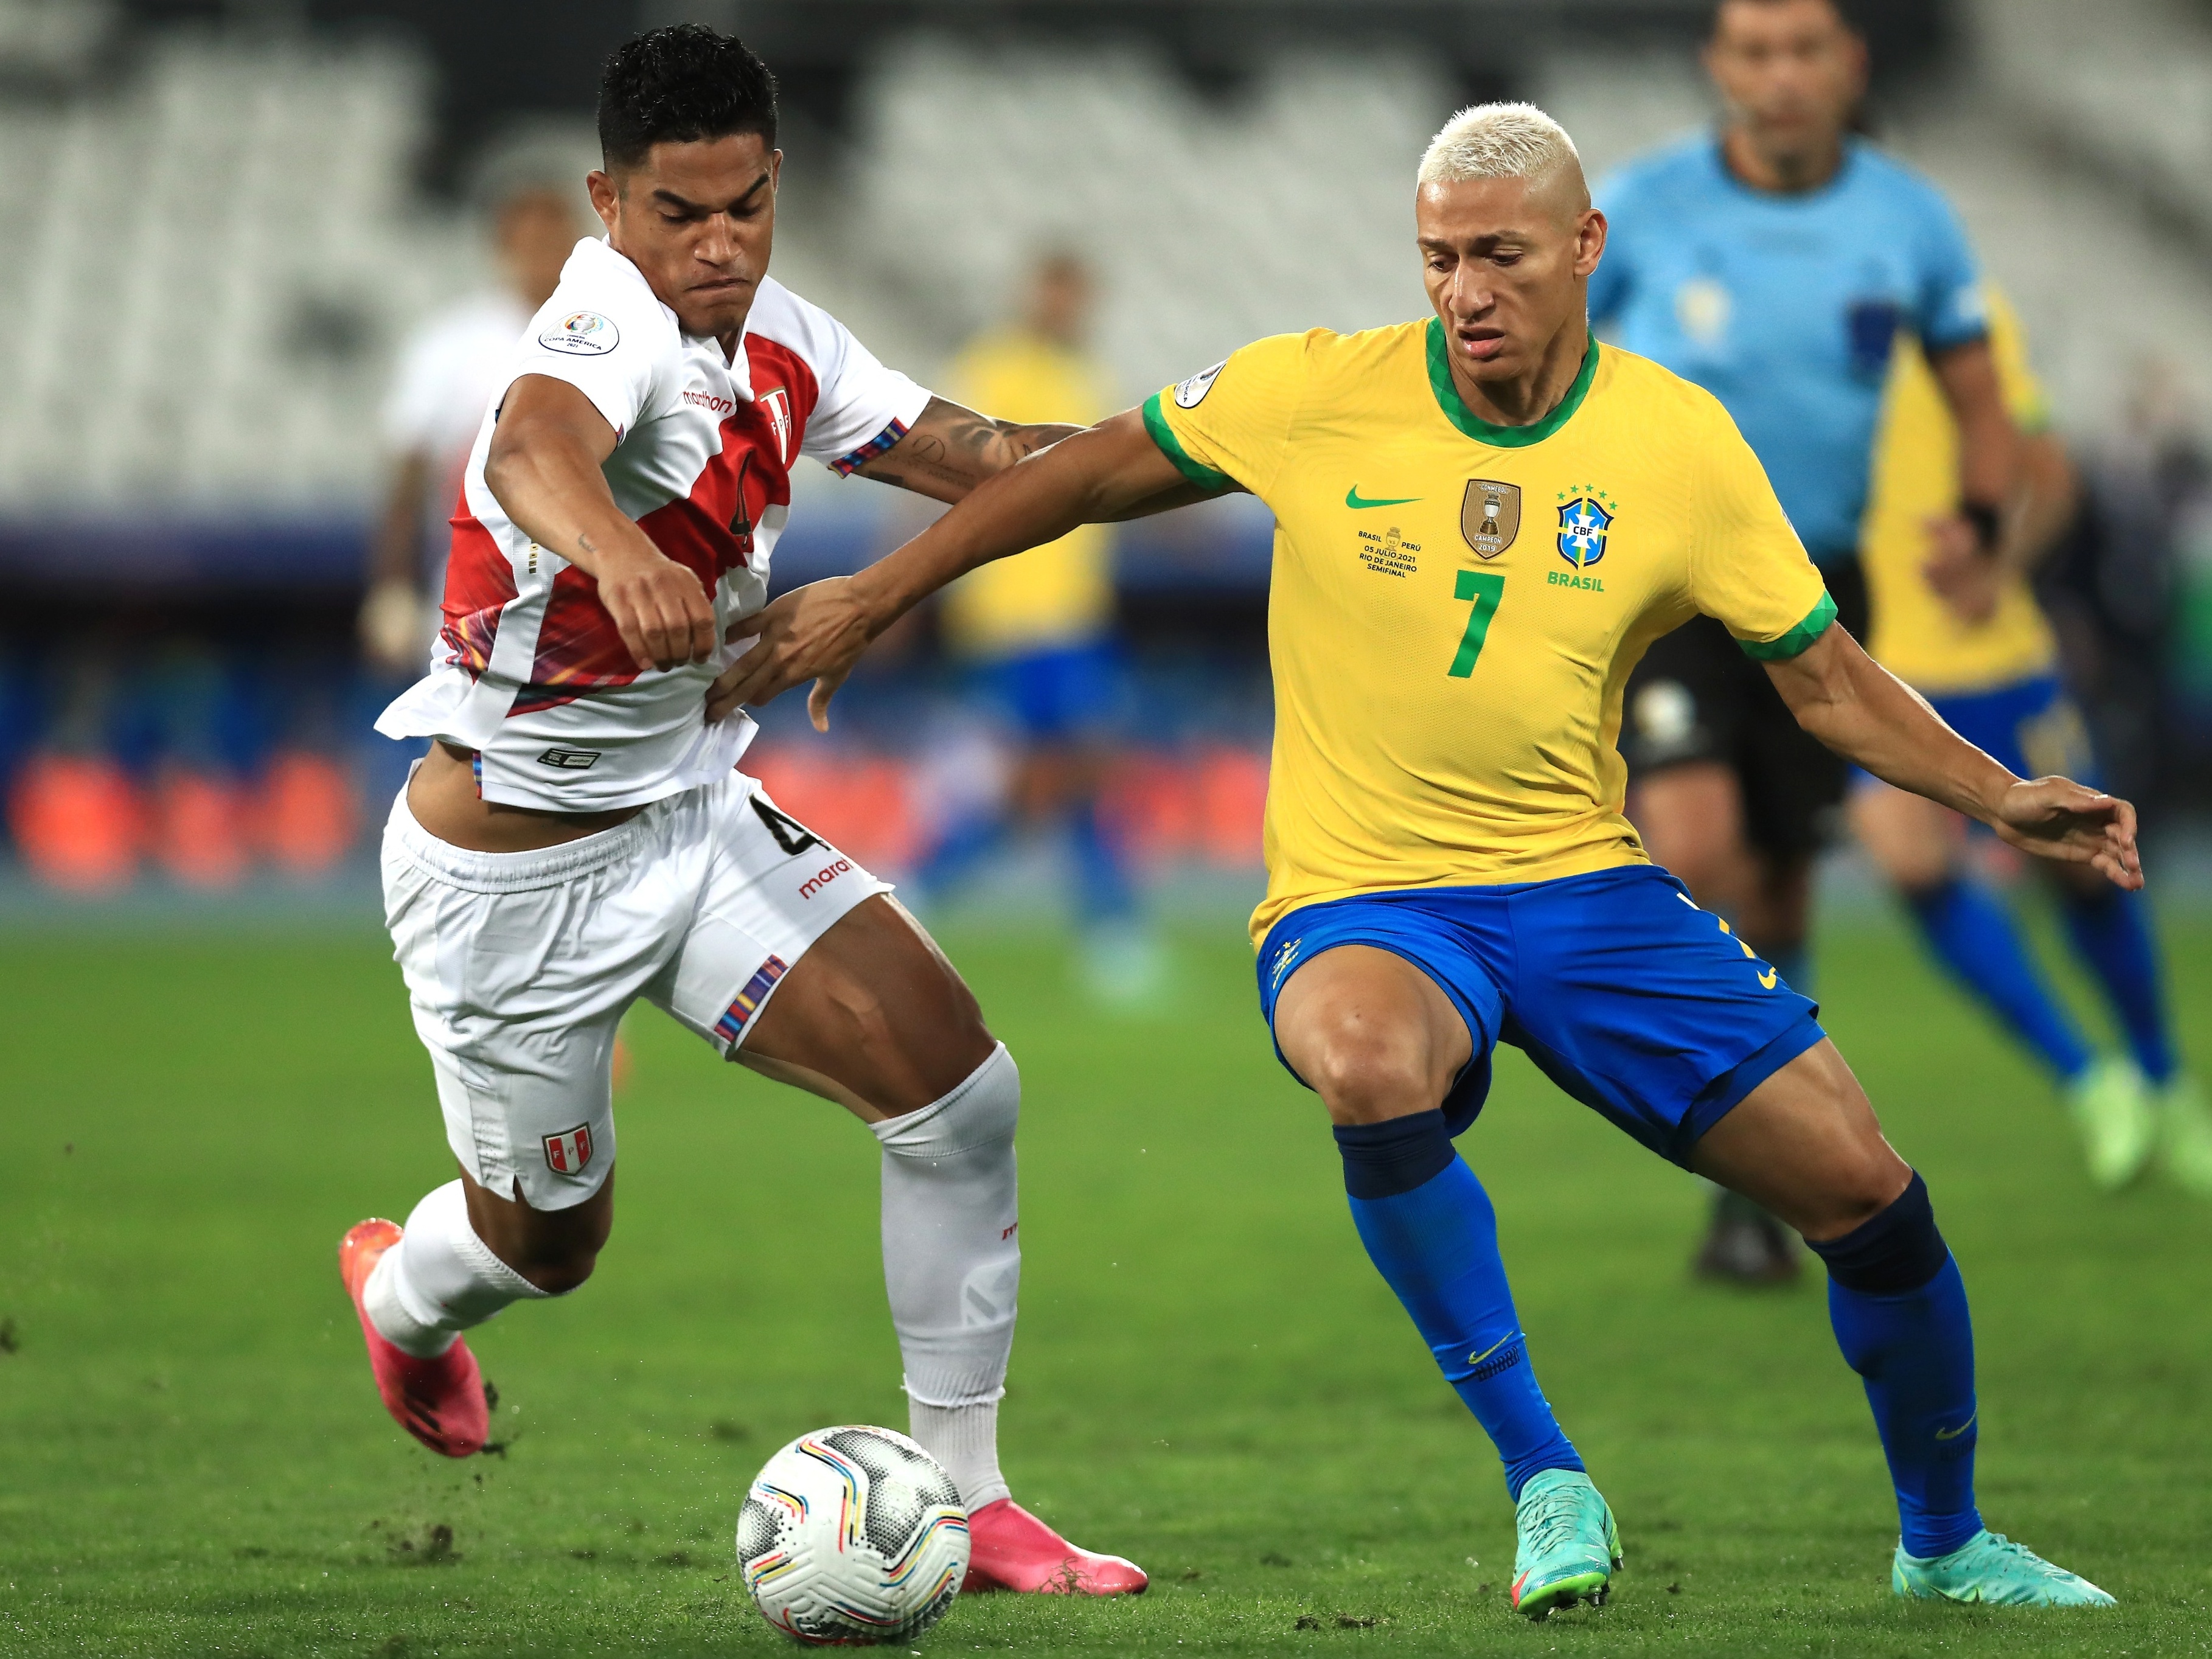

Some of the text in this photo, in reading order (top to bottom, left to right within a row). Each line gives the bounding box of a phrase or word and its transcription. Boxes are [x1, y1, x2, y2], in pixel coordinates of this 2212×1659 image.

[566, 338, 601, 350] AMERICA
[683, 391, 732, 413] marathon
[1481, 484, 1508, 493] CONMEBOL
[1475, 534, 1502, 544] CAMPEON
[1573, 526, 1593, 537] CBF
[1358, 530, 1382, 542] BRASIL
[1401, 541, 1421, 552] PERÚ
[1359, 552, 1373, 562] RIO
[1385, 560, 1417, 572] JANEIRO
[1375, 549, 1396, 558] JULIO
[1398, 554, 1416, 563] 2021
[1367, 564, 1406, 578] SEMIFINAL
[1547, 571, 1605, 593] BRASIL
[1447, 569, 1505, 678] 7
[748, 792, 832, 857] 4
